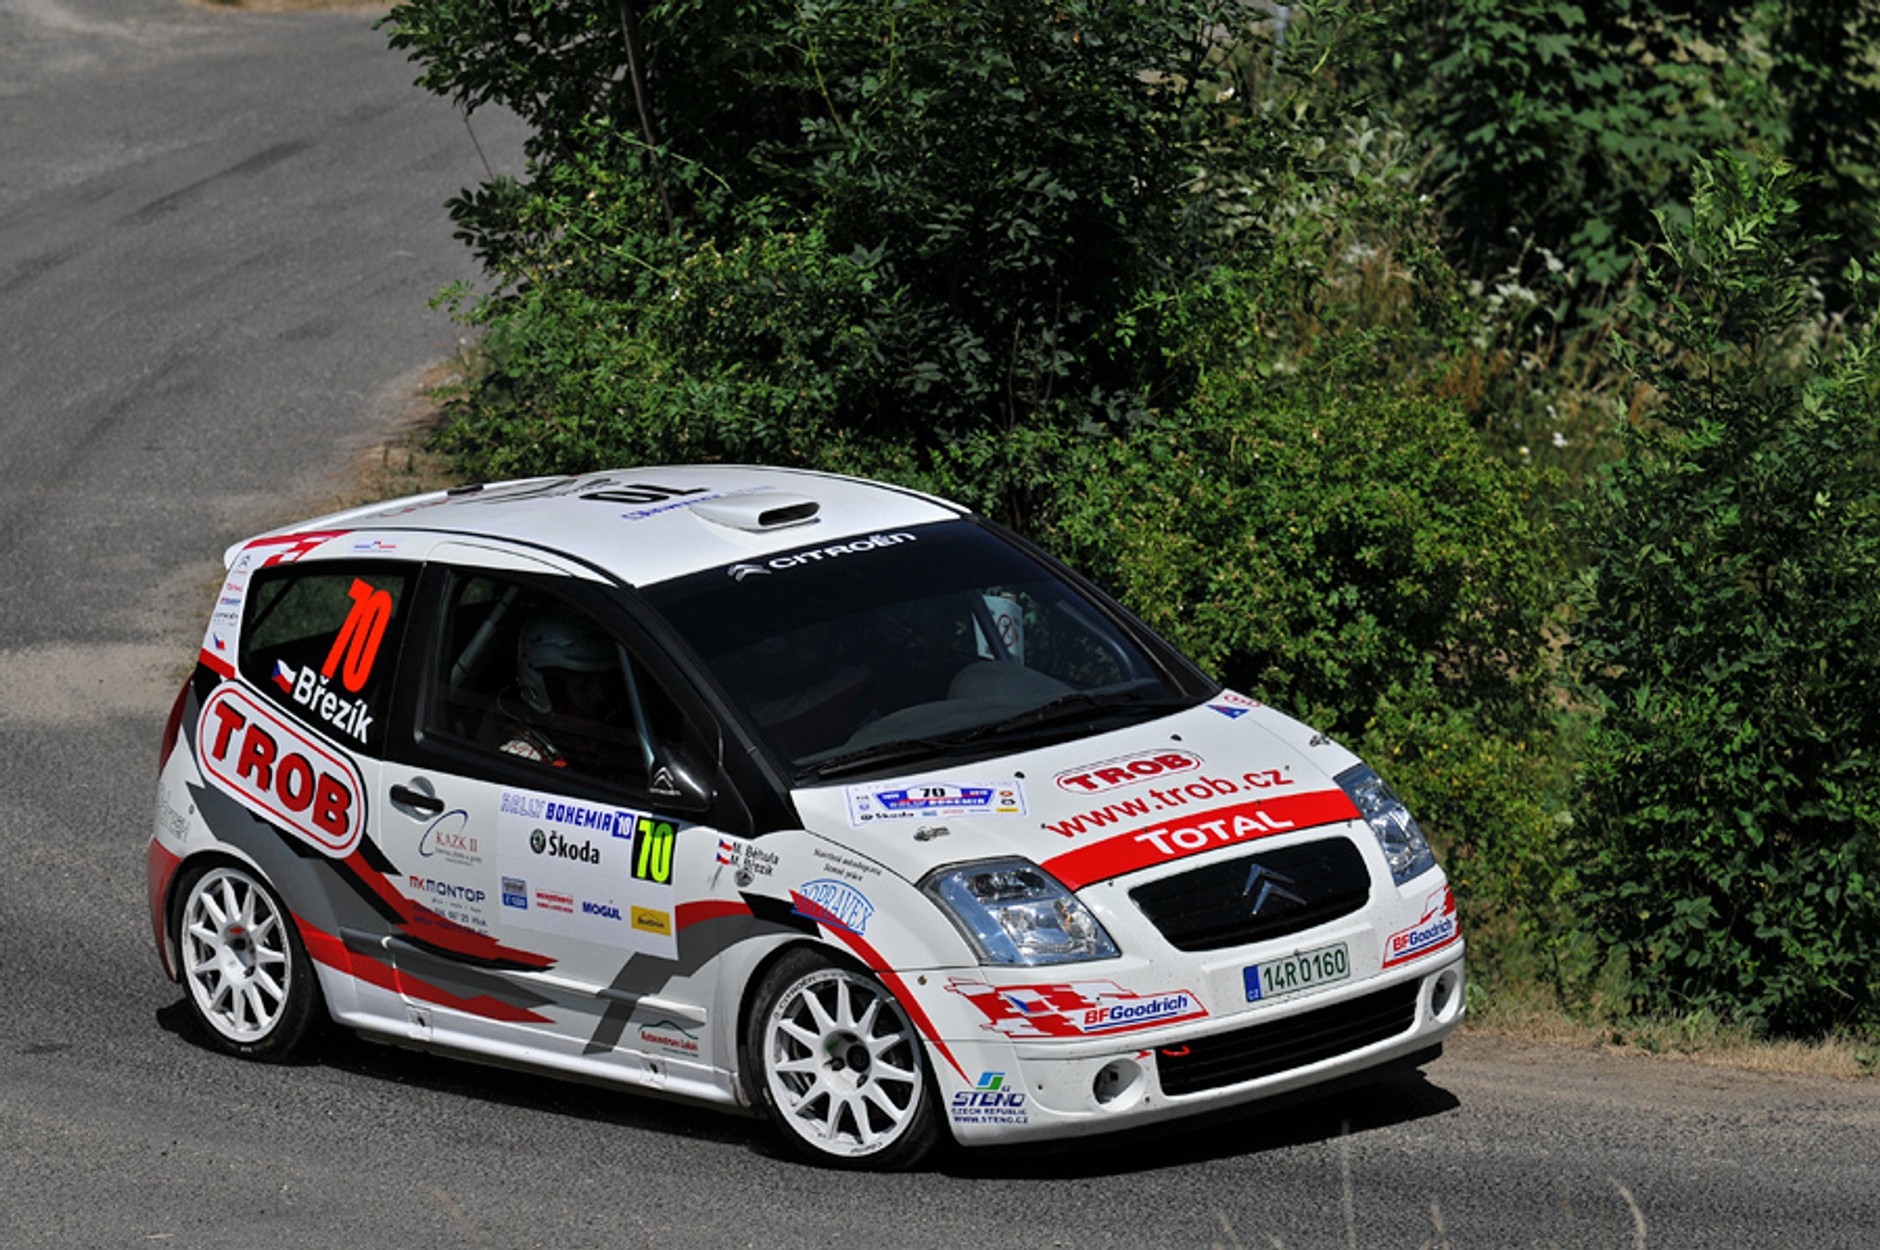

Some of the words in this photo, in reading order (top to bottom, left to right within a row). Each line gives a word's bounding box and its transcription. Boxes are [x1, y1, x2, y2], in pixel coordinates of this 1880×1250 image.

[321, 577, 393, 694] 70
[292, 665, 374, 745] Březík
[211, 700, 352, 838] TROB
[1062, 752, 1194, 791] TROB
[919, 787, 946, 798] 70
[1044, 768, 1295, 839] www.trob.cz
[545, 802, 613, 832] BOHEMIA
[1133, 810, 1295, 856] TOTAL
[548, 829, 600, 865] Škoda
[636, 818, 674, 883] 70
[582, 900, 622, 921] MOGUL
[1392, 917, 1454, 953] BFGoodrich
[1083, 993, 1189, 1026] BFGoodrich
[952, 1090, 1026, 1108] STENO
[987, 1107, 1027, 1116] REPUBLIC
[953, 1115, 1028, 1125] WWW.STENO.CZ
